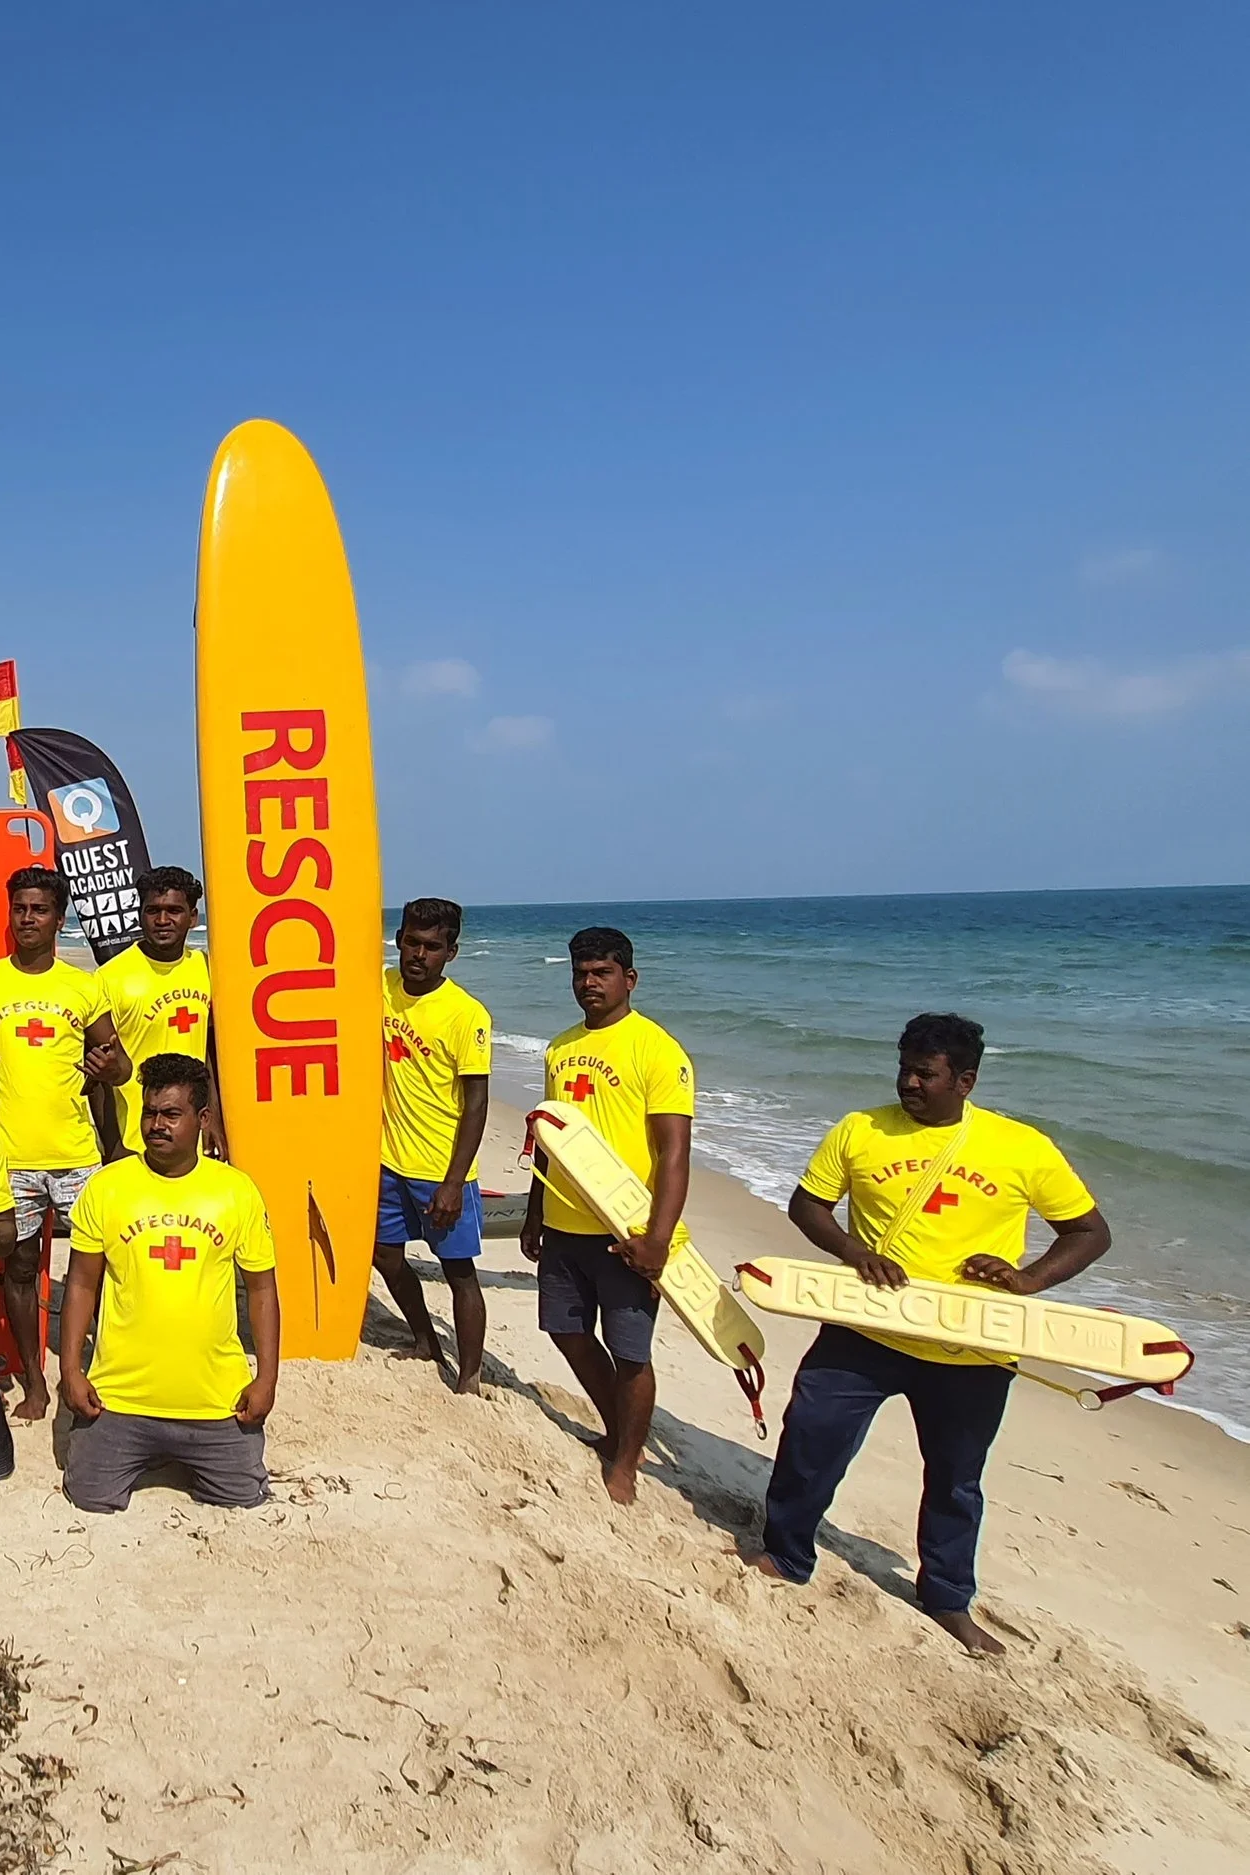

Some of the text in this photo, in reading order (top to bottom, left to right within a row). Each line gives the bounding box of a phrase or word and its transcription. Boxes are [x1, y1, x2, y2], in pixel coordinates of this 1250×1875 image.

[63, 788, 102, 834] Q
[61, 840, 129, 877] QUEST
[69, 867, 133, 896] ACADEMY
[241, 709, 339, 1102] RESCUE
[384, 1016, 431, 1057] EGUARD
[550, 1056, 620, 1087] LIFEGUARD
[120, 1213, 224, 1247] LIFEGUARD
[796, 1274, 1012, 1342] RESCUE
